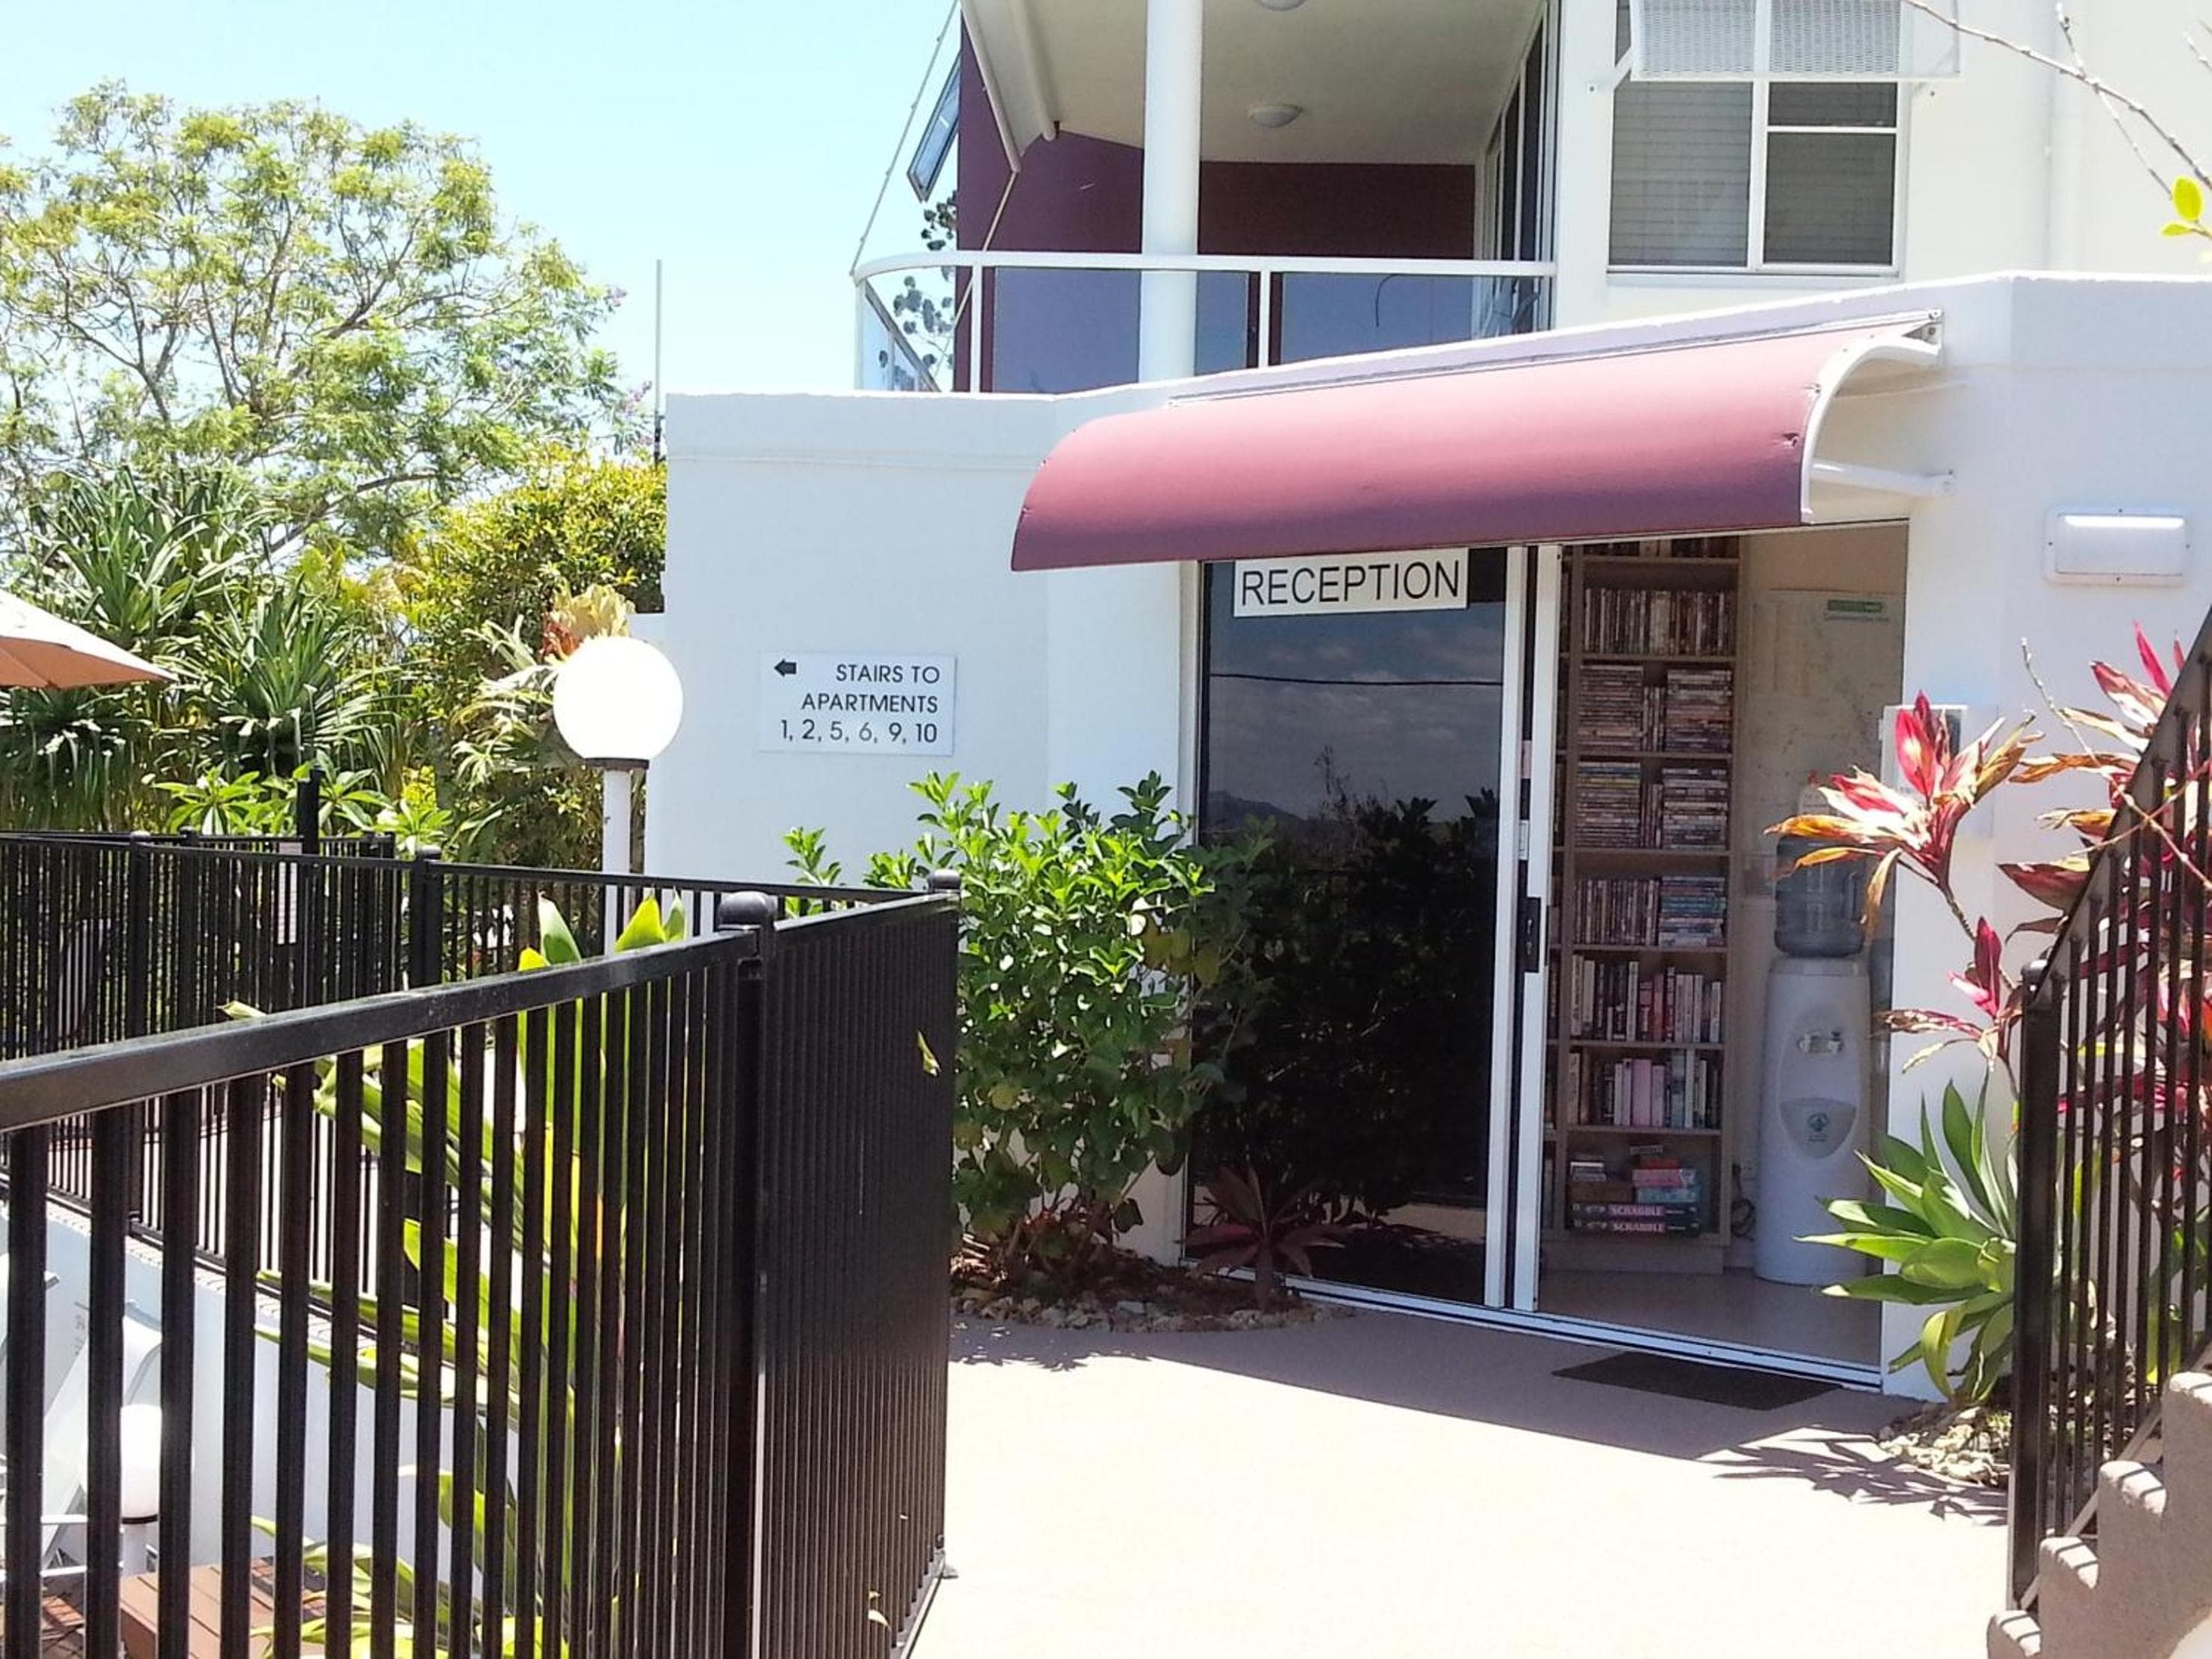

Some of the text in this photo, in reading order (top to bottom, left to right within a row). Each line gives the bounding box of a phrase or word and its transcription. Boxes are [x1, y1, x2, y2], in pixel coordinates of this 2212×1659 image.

[1242, 560, 1459, 605] RECEPTION
[836, 664, 941, 684] STAIRS TO
[801, 693, 938, 713] APARTMENTS
[782, 719, 938, 744] 1, 2, 5, 6, 9, 10
